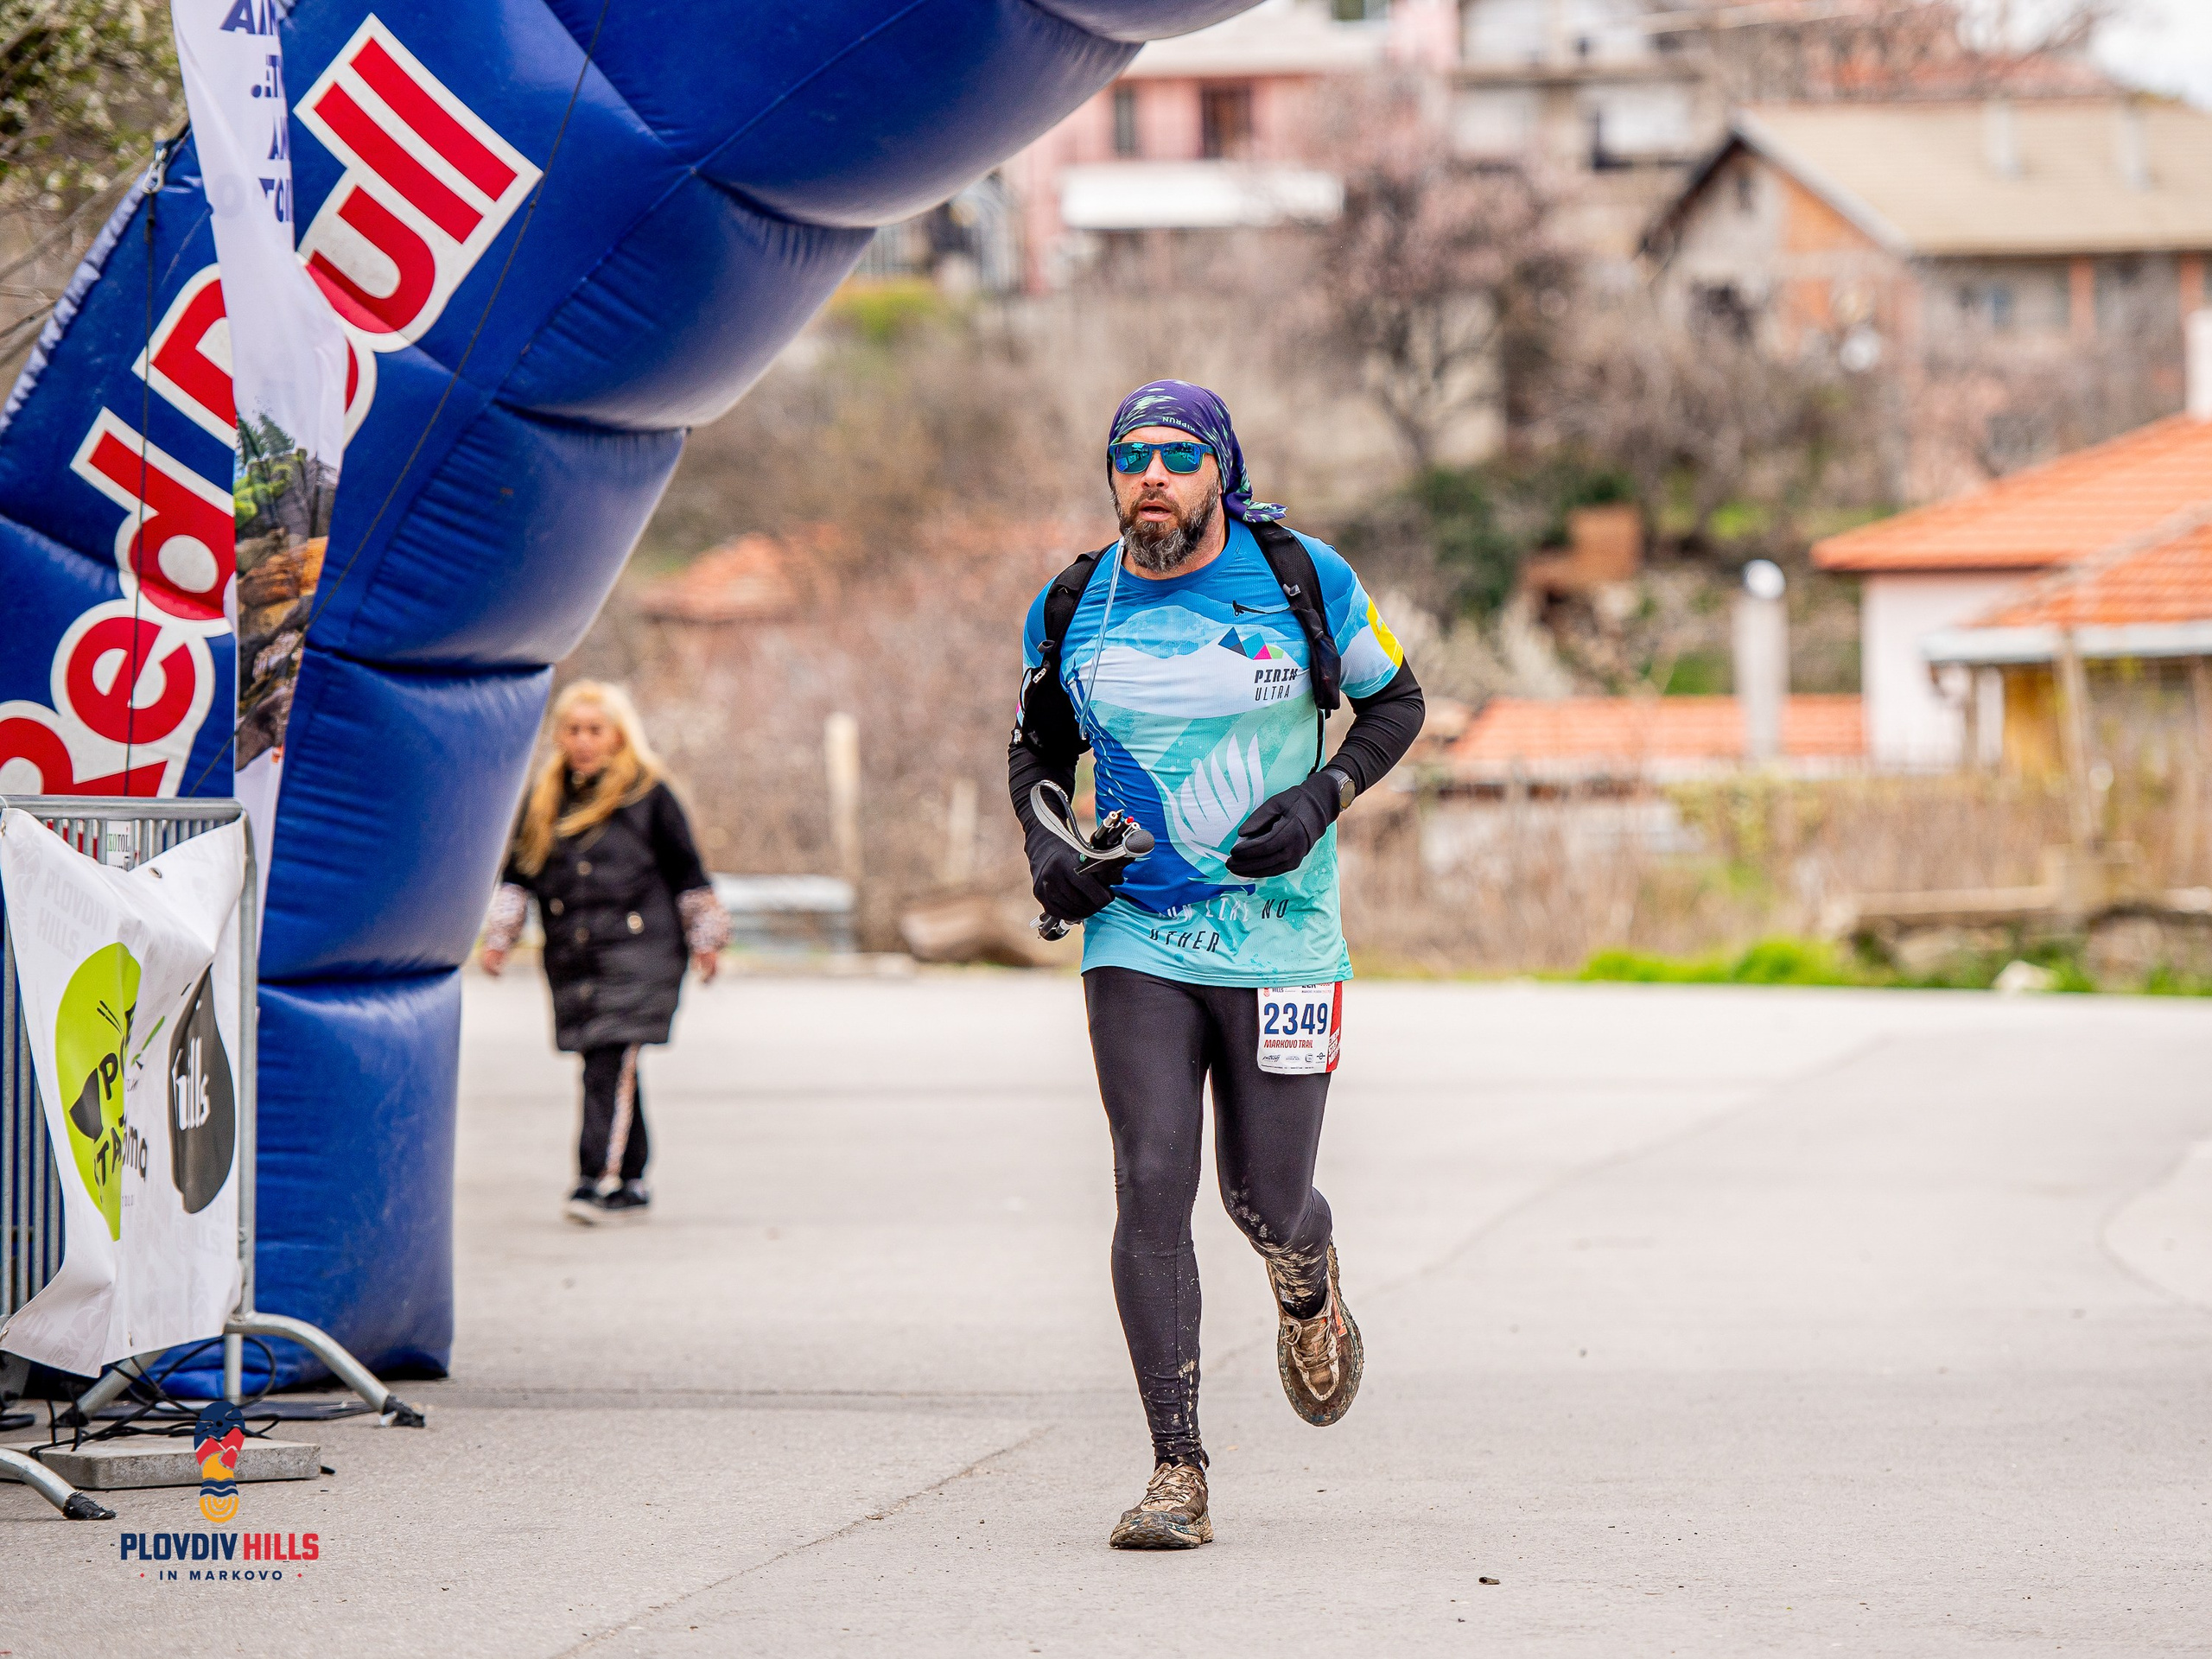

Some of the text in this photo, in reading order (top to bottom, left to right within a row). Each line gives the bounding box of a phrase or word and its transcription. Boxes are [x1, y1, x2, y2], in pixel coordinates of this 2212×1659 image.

[1162, 416, 1196, 433] KIPRUN
[1254, 668, 1299, 683] PIRIN
[1255, 684, 1290, 701] ULTRA
[43, 868, 110, 937] PLOVDIV
[1158, 903, 1192, 922] UN
[1261, 899, 1290, 919] NO
[37, 906, 80, 961] HILLS
[1263, 1002, 1328, 1035] 2349
[1263, 1039, 1313, 1049] MARKOVO TRAIL
